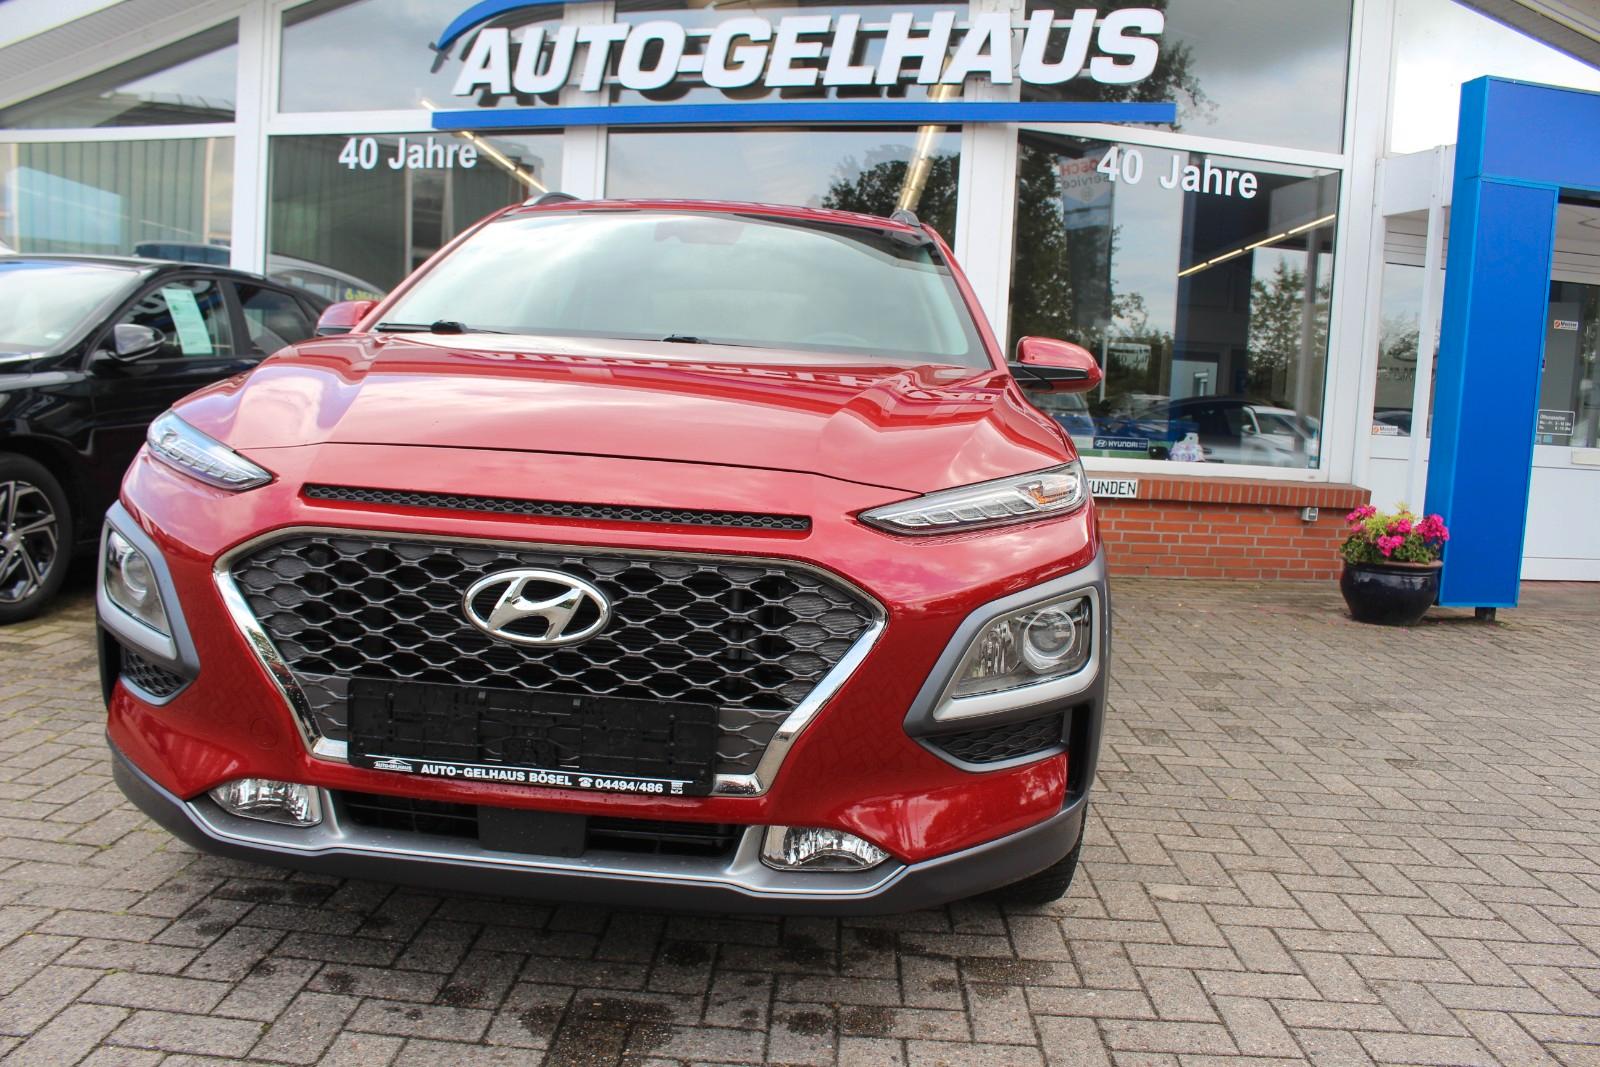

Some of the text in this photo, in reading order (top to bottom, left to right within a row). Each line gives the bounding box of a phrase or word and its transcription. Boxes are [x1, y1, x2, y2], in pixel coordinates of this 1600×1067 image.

[453, 8, 1164, 97] AUTO-GELHAUS
[338, 136, 477, 169] 40 Jahre
[1097, 146, 1258, 198] 40 Jahre
[1108, 440, 1139, 448] HYUNDAI
[1088, 480, 1136, 495] UNDEN
[421, 764, 525, 782] AUTO-GELHAUS
[529, 771, 572, 786] BÖSEL
[595, 778, 664, 793] 04494/486
